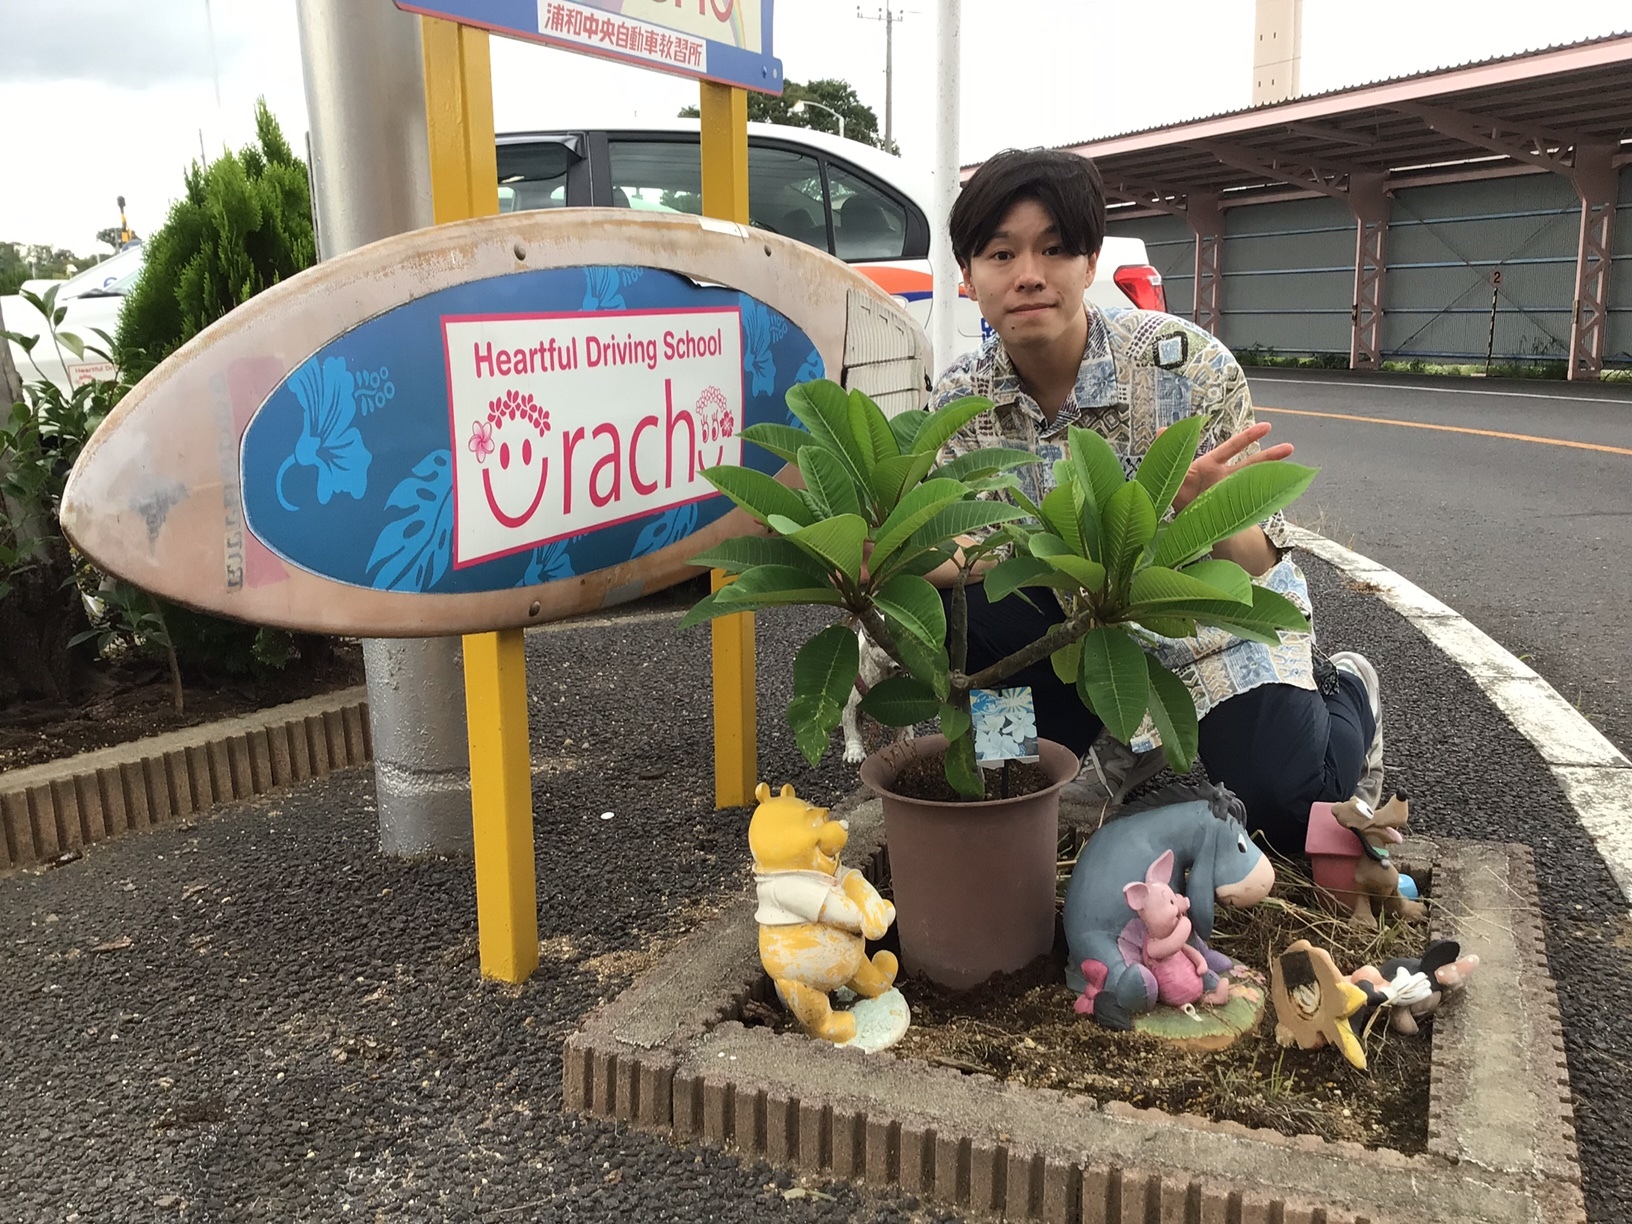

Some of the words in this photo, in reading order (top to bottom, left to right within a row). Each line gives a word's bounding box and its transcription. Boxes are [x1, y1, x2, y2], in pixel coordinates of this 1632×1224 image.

[544, 3, 703, 68] 浦和中央自動車教習所
[1493, 271, 1501, 284] 2
[473, 336, 578, 378] Heartful
[585, 333, 657, 370] Driving
[663, 328, 722, 360] School
